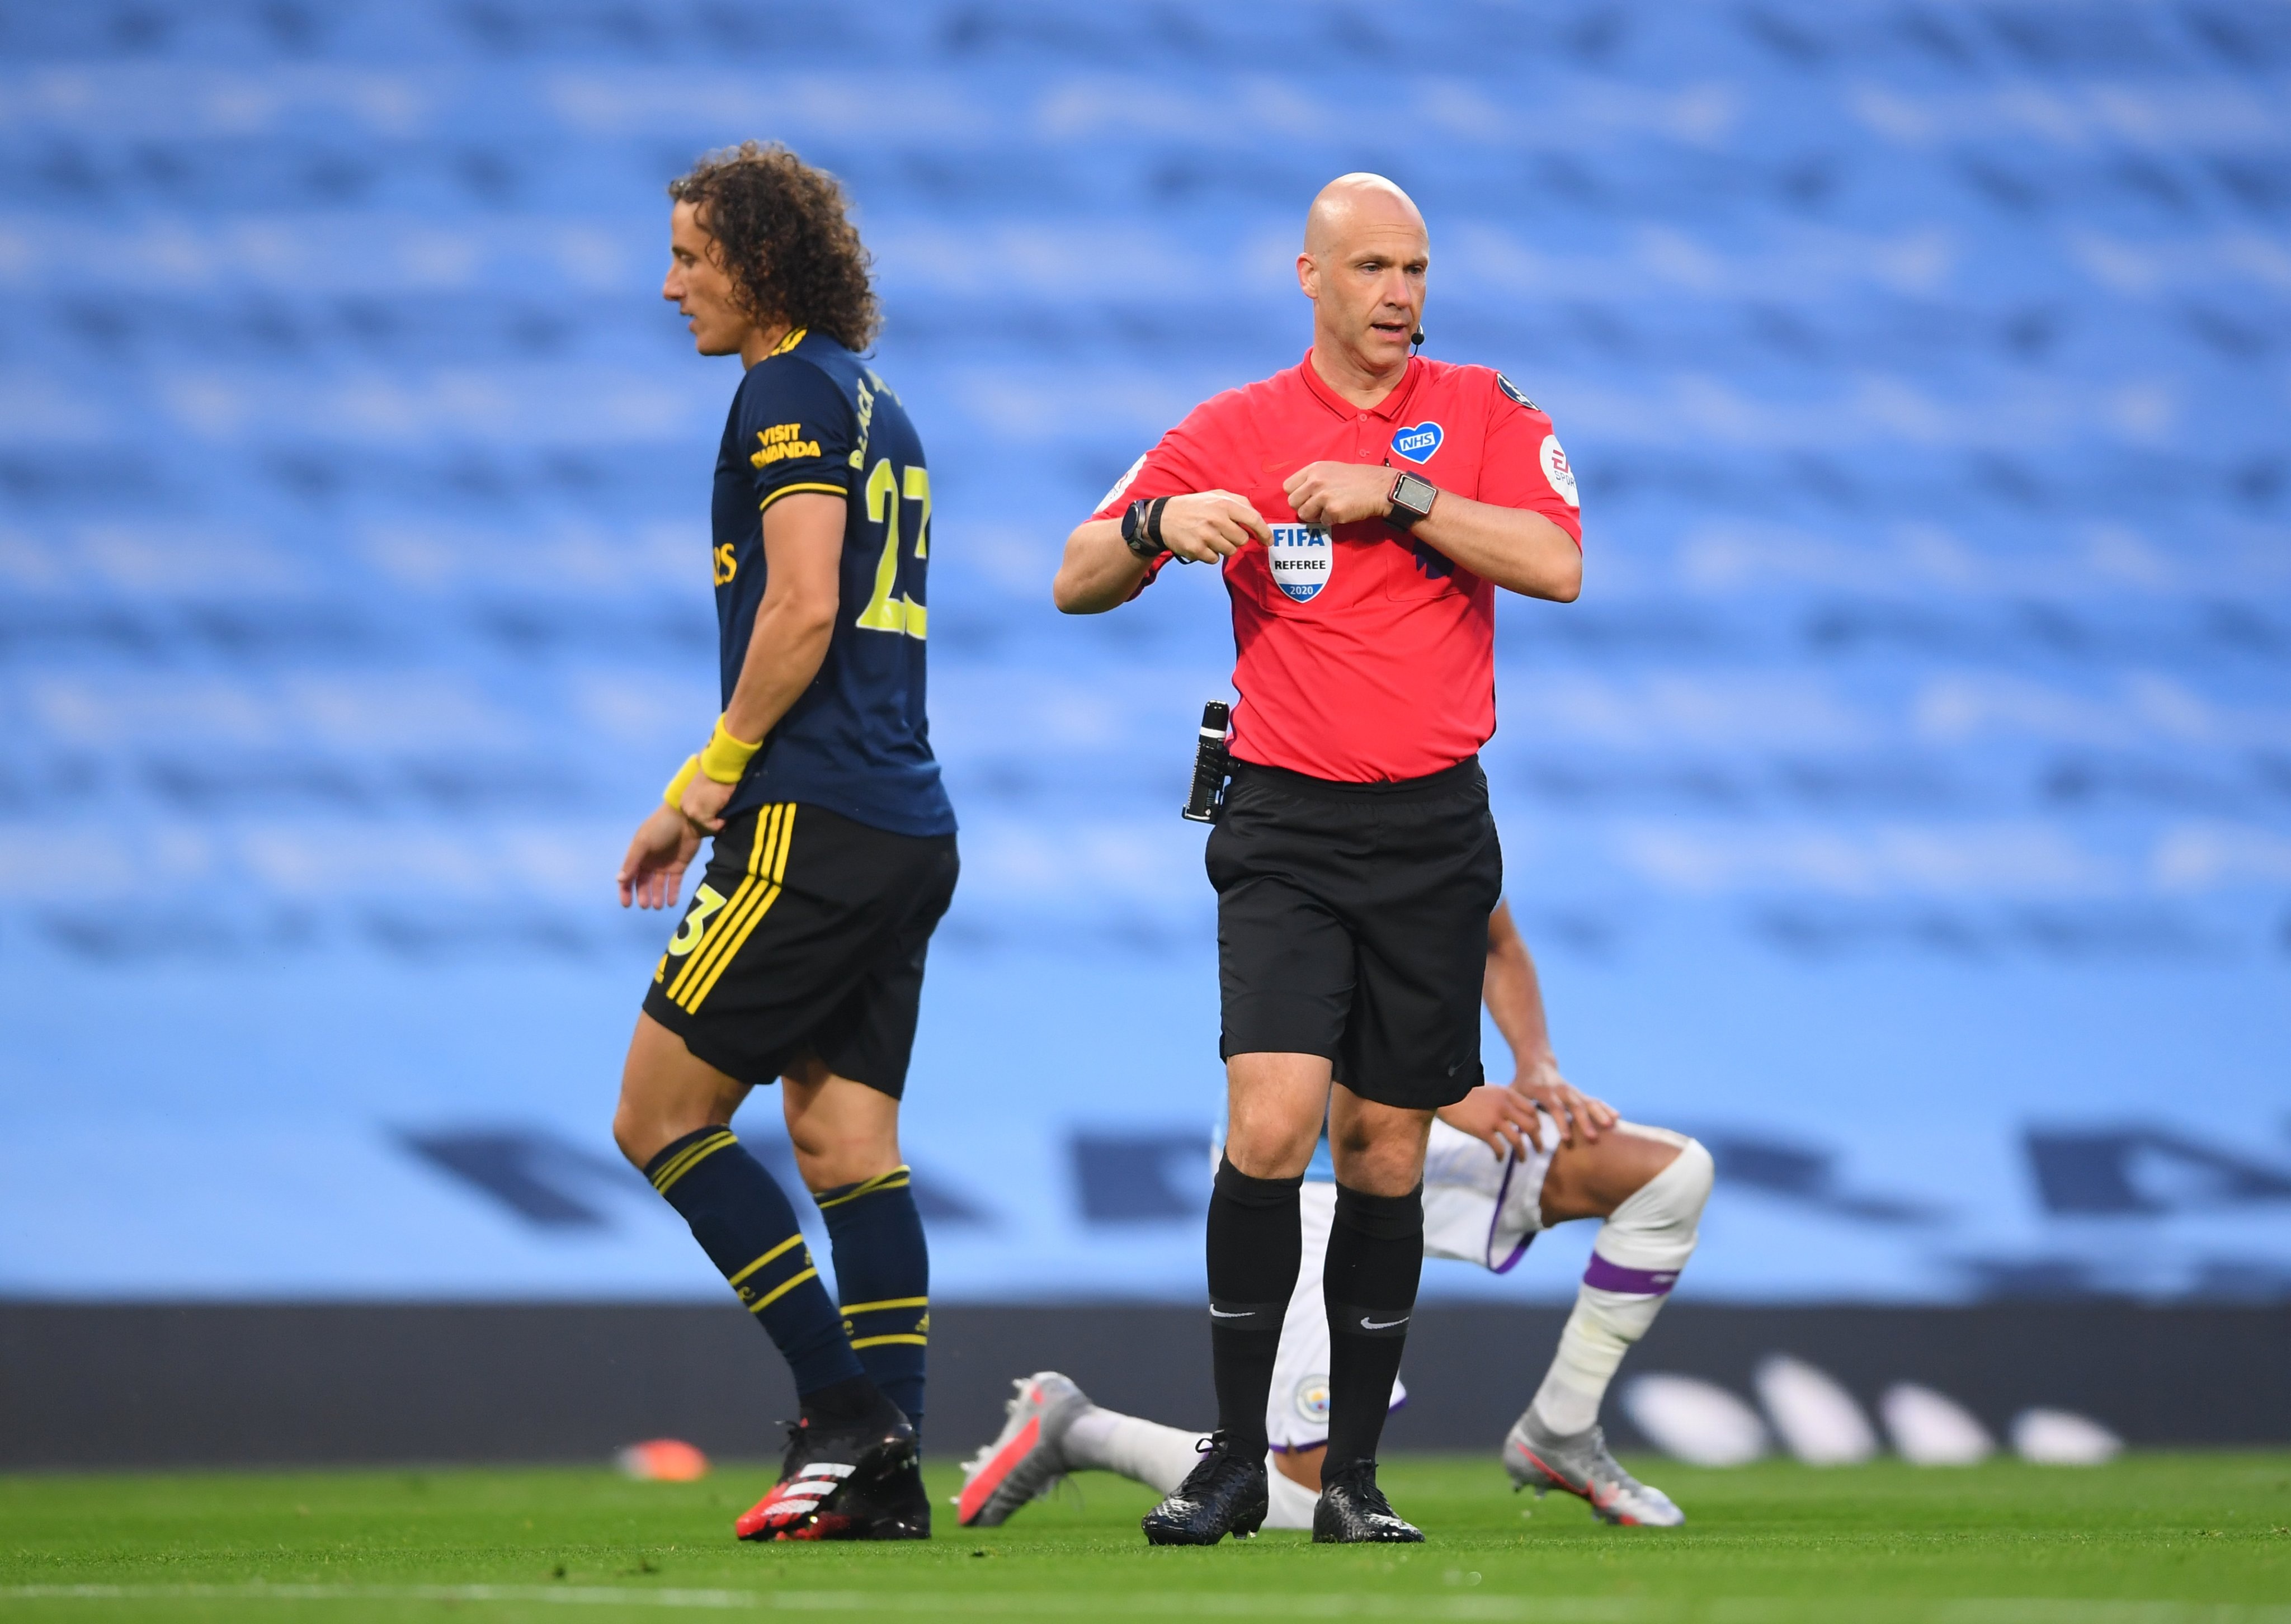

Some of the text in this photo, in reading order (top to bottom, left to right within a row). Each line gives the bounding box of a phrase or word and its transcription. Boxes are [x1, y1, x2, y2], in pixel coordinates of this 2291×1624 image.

[756, 423, 801, 447] VISIT
[1403, 433, 1432, 450] NHS
[1273, 528, 1325, 547] FIFA
[1274, 560, 1326, 570] REFEREE
[1290, 586, 1313, 594] 2020
